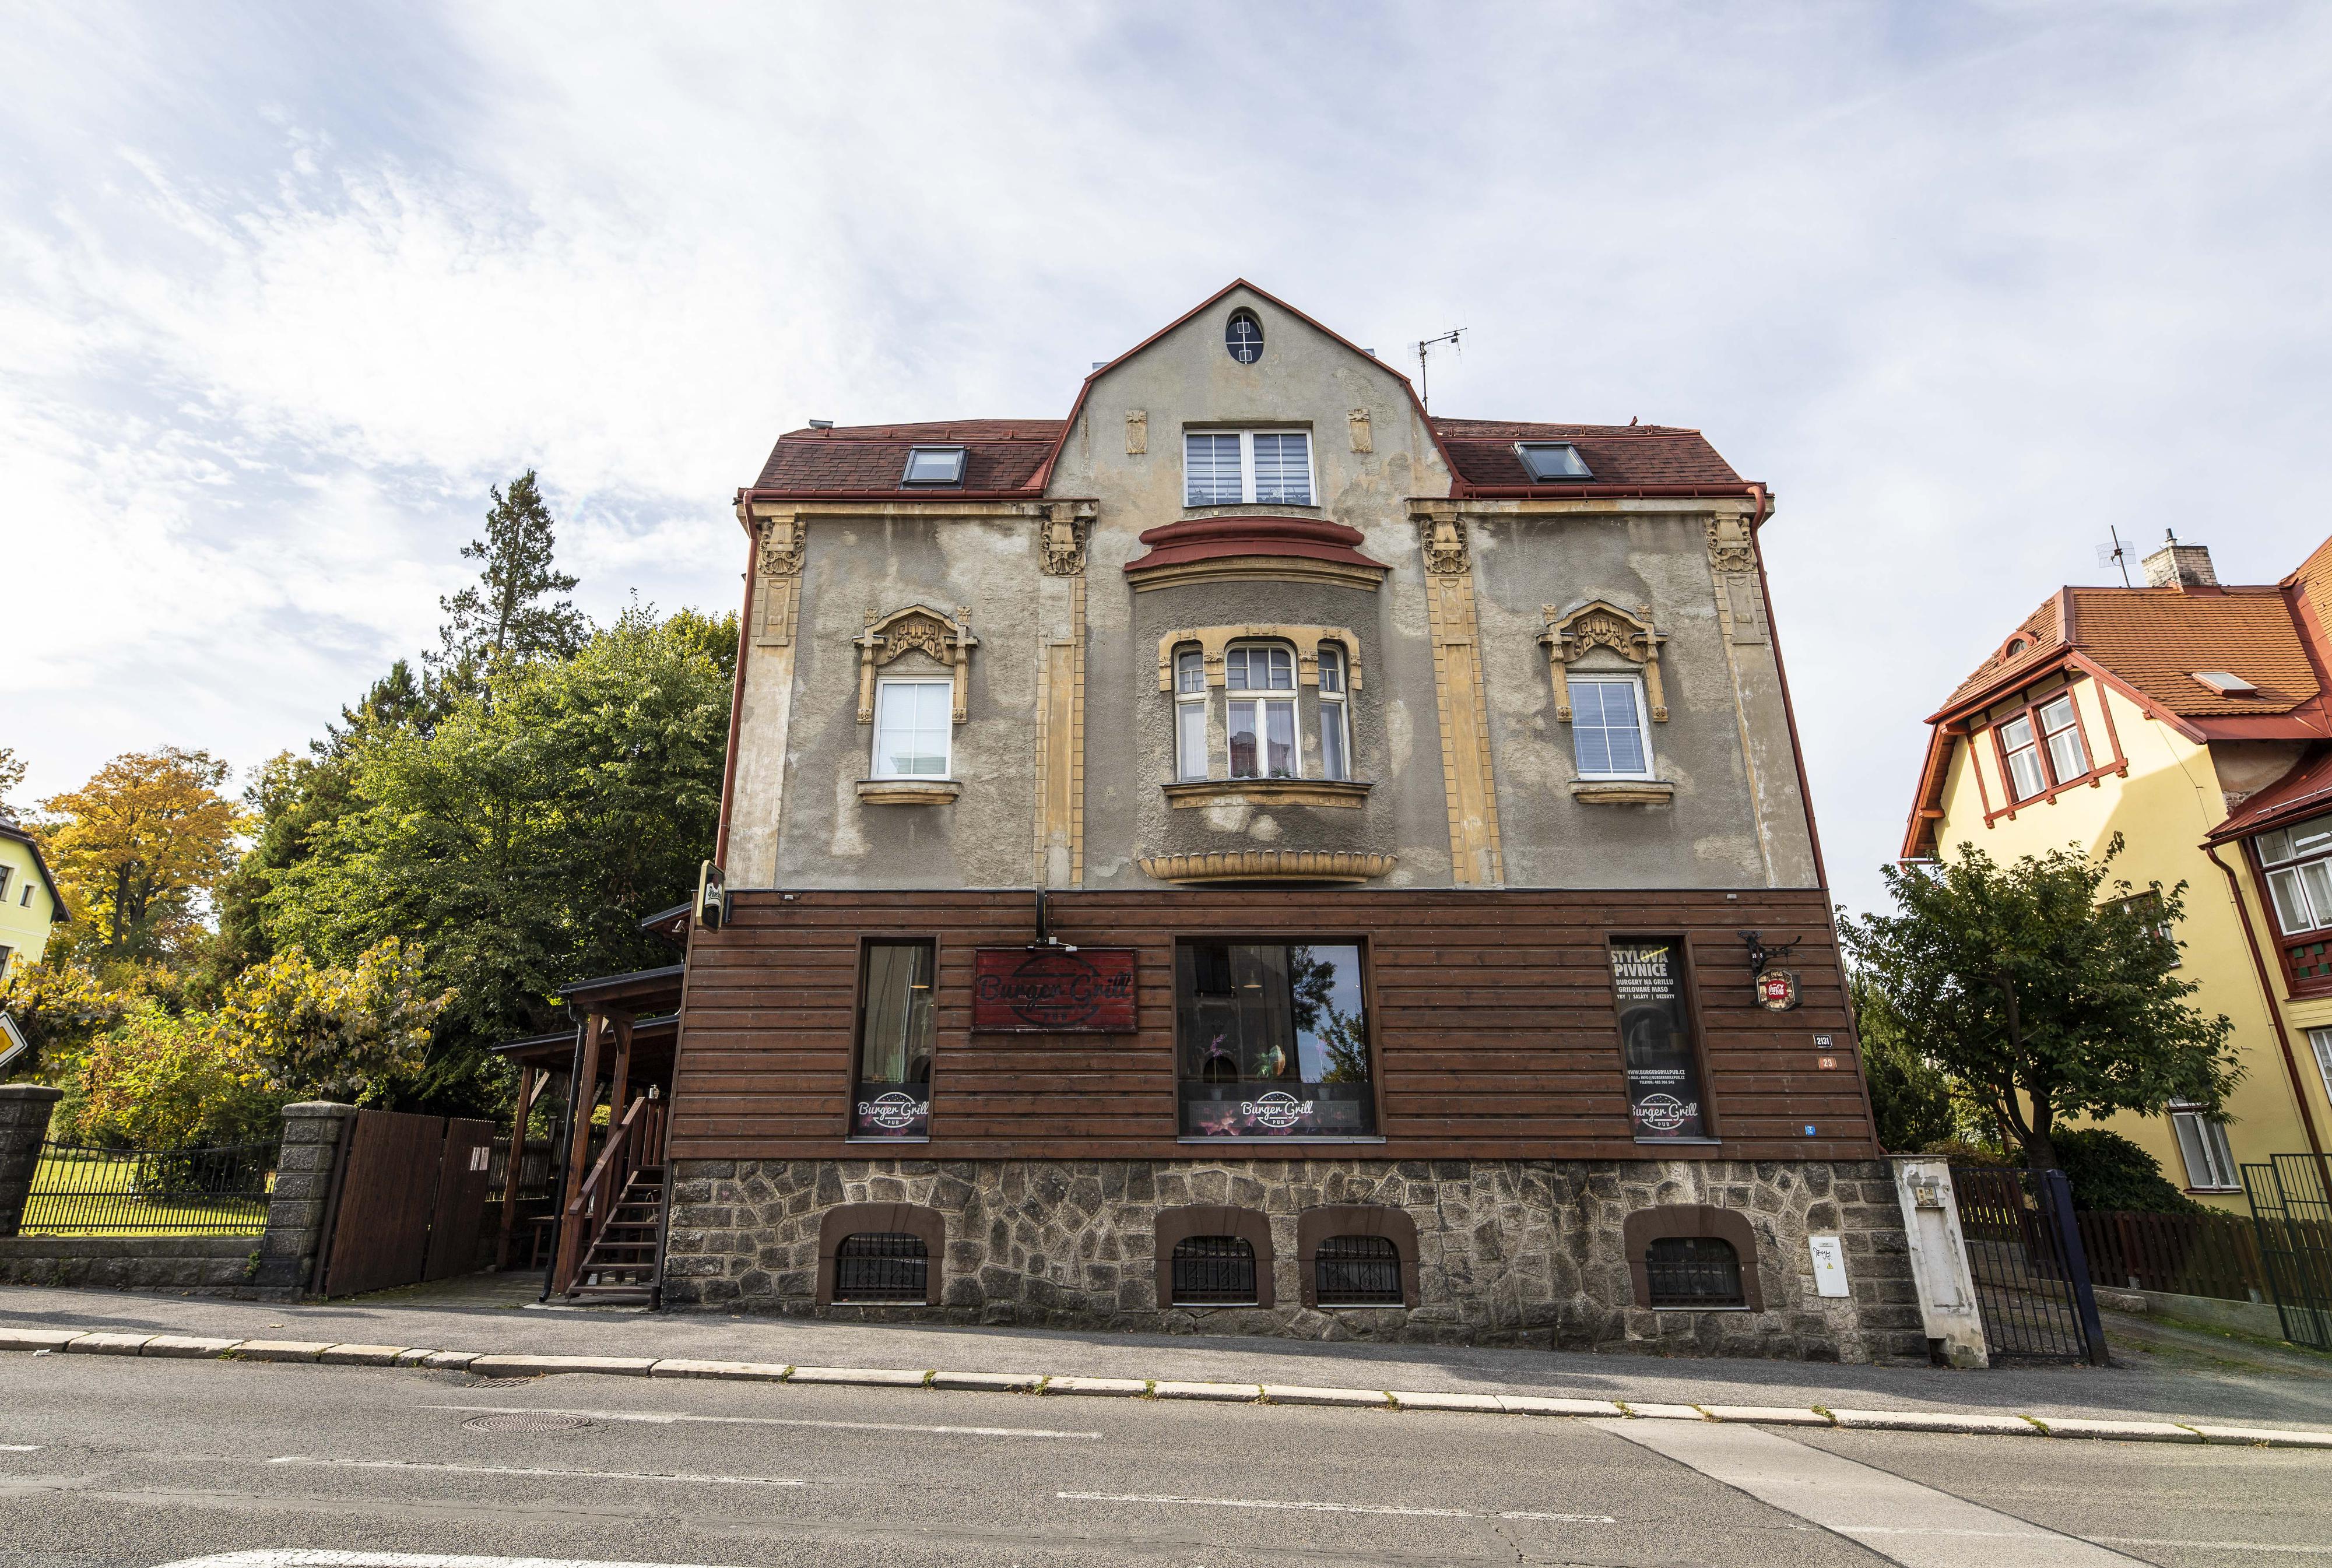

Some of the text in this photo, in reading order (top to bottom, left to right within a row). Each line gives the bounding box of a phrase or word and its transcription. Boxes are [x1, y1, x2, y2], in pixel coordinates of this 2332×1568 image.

[1611, 947, 1669, 963] STYLOVÁ
[1614, 964, 1667, 976] PIVNICE
[978, 971, 1132, 1011] Burger Grill
[1823, 1059, 1832, 1067] 23
[858, 1101, 929, 1120] Burger Grill
[1241, 1101, 1313, 1120] Burger Grill
[1669, 1102, 1698, 1121] Grill
